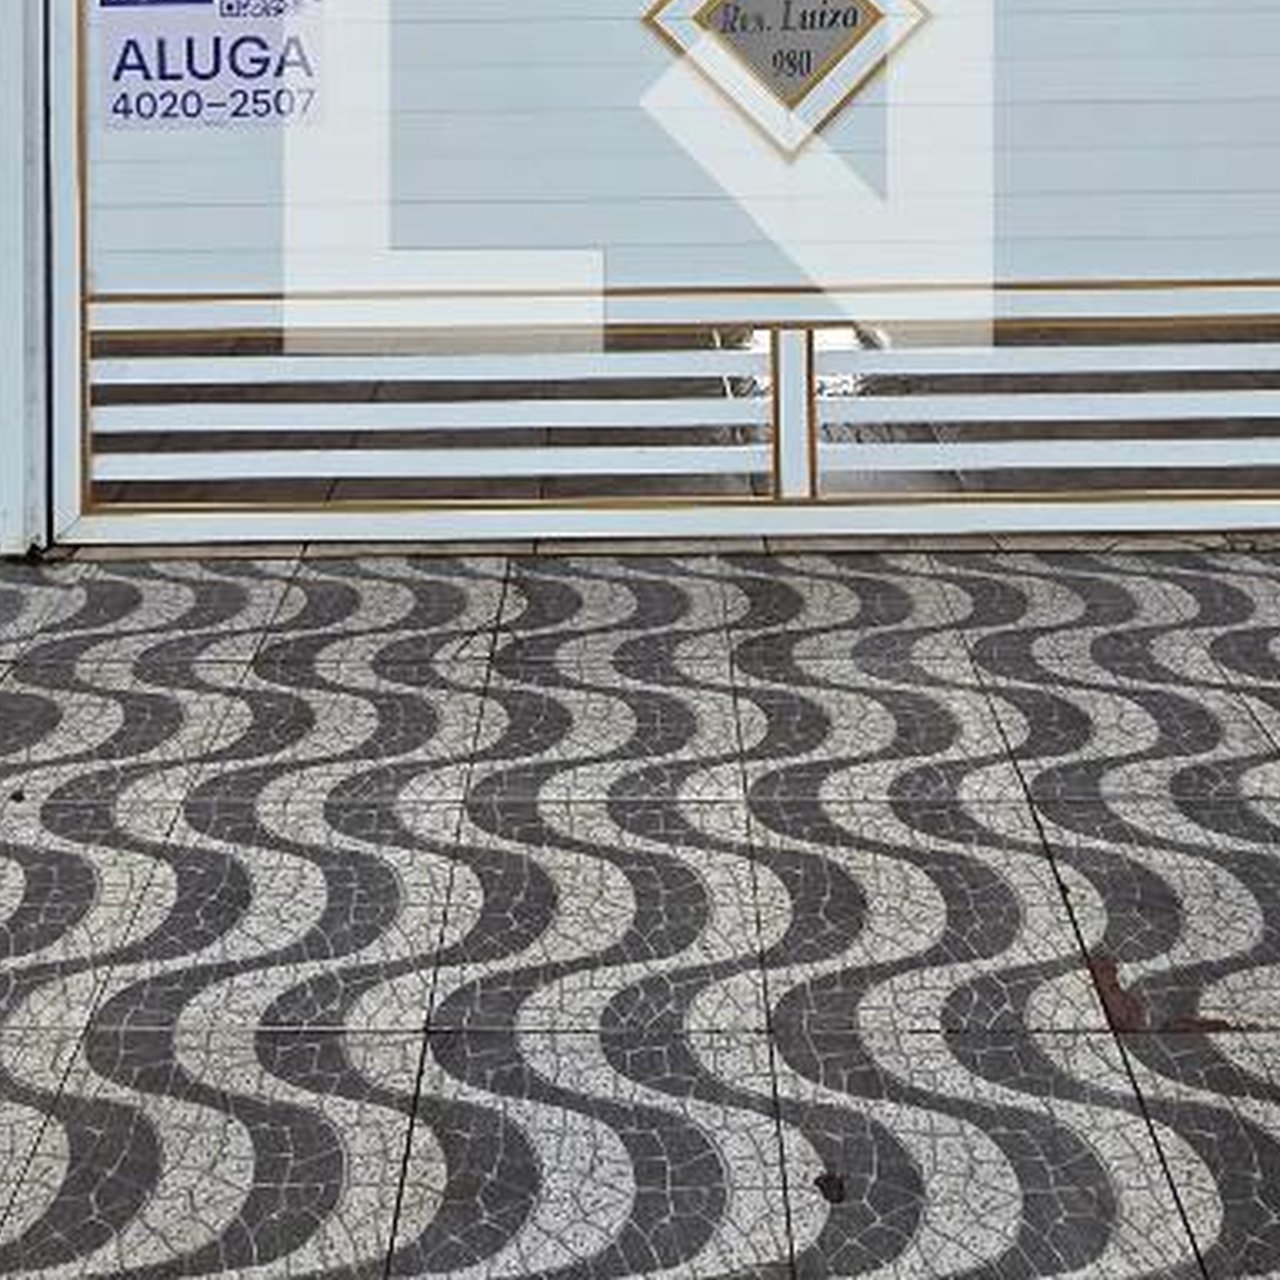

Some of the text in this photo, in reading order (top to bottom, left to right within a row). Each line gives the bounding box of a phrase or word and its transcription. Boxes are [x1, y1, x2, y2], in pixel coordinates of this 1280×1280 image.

[112, 35, 313, 81] ALUGA
[771, 49, 812, 78] 980
[111, 89, 315, 120] 4020-2507
